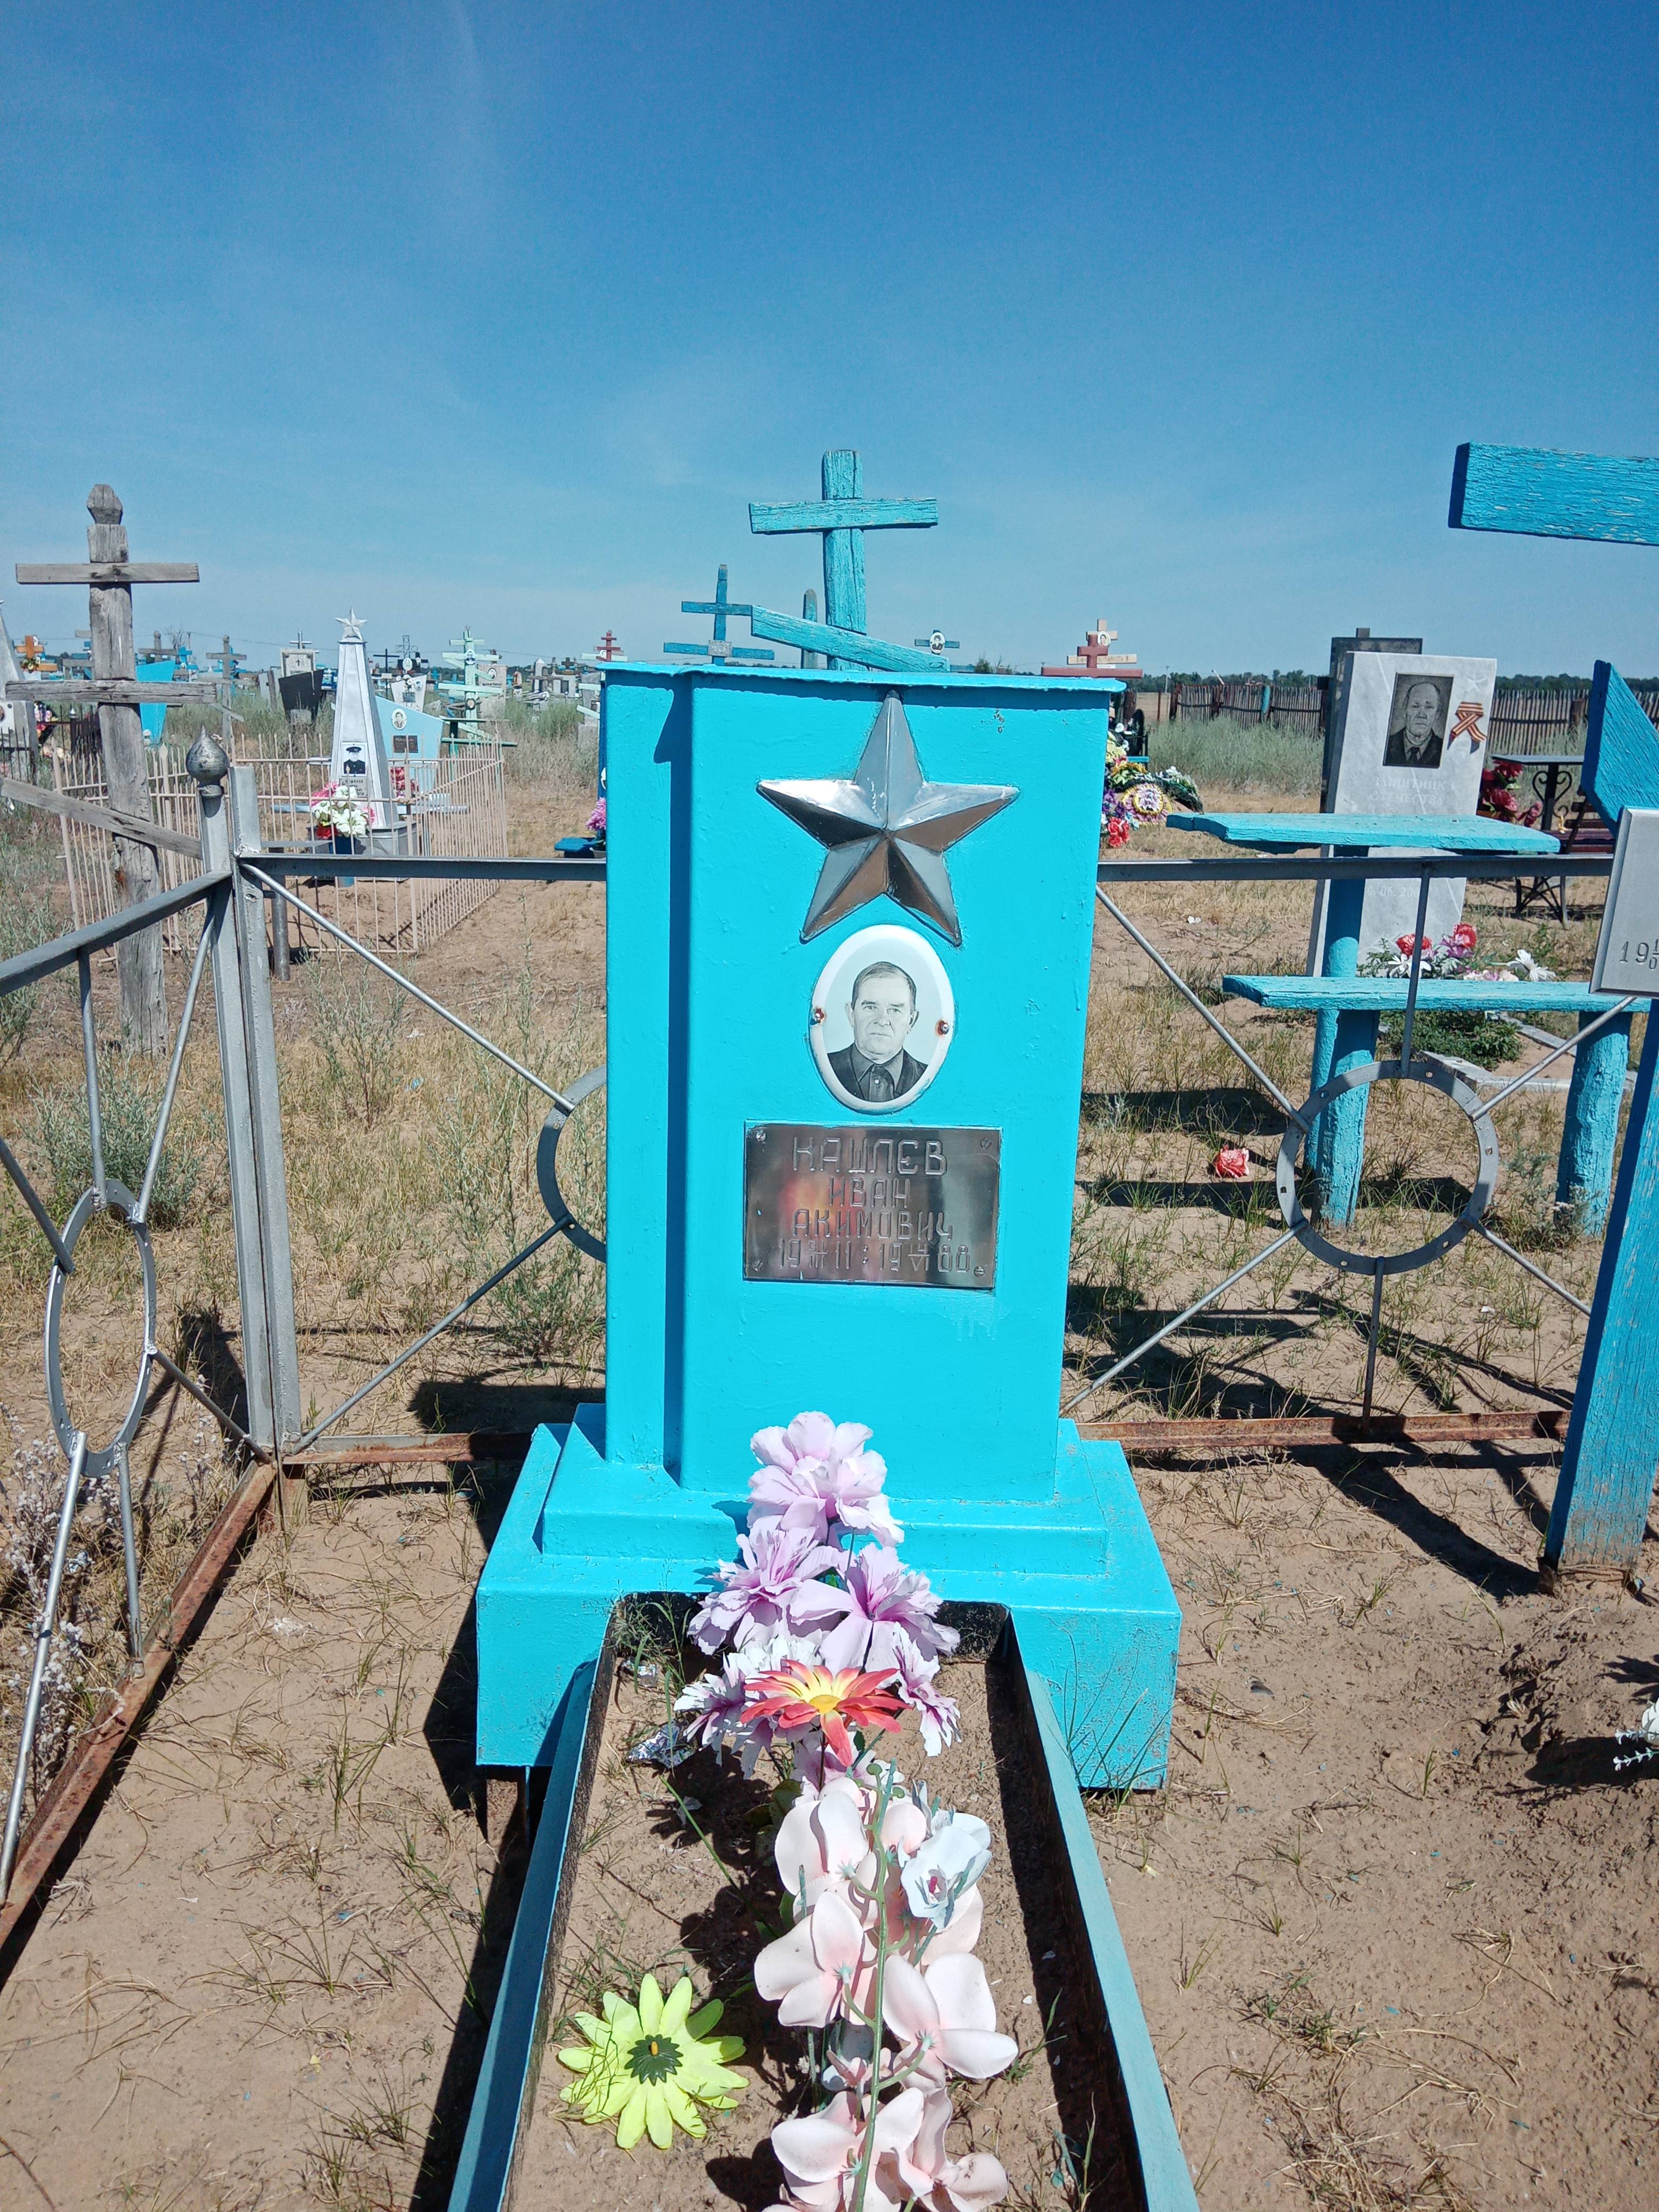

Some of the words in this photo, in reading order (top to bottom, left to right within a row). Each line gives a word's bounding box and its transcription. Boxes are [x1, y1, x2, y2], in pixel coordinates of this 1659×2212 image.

[793, 1137, 948, 1176] КАШЛЕВ
[828, 1177, 911, 1208] ИВАН
[792, 1209, 953, 1241] АКИМОВИЧ
